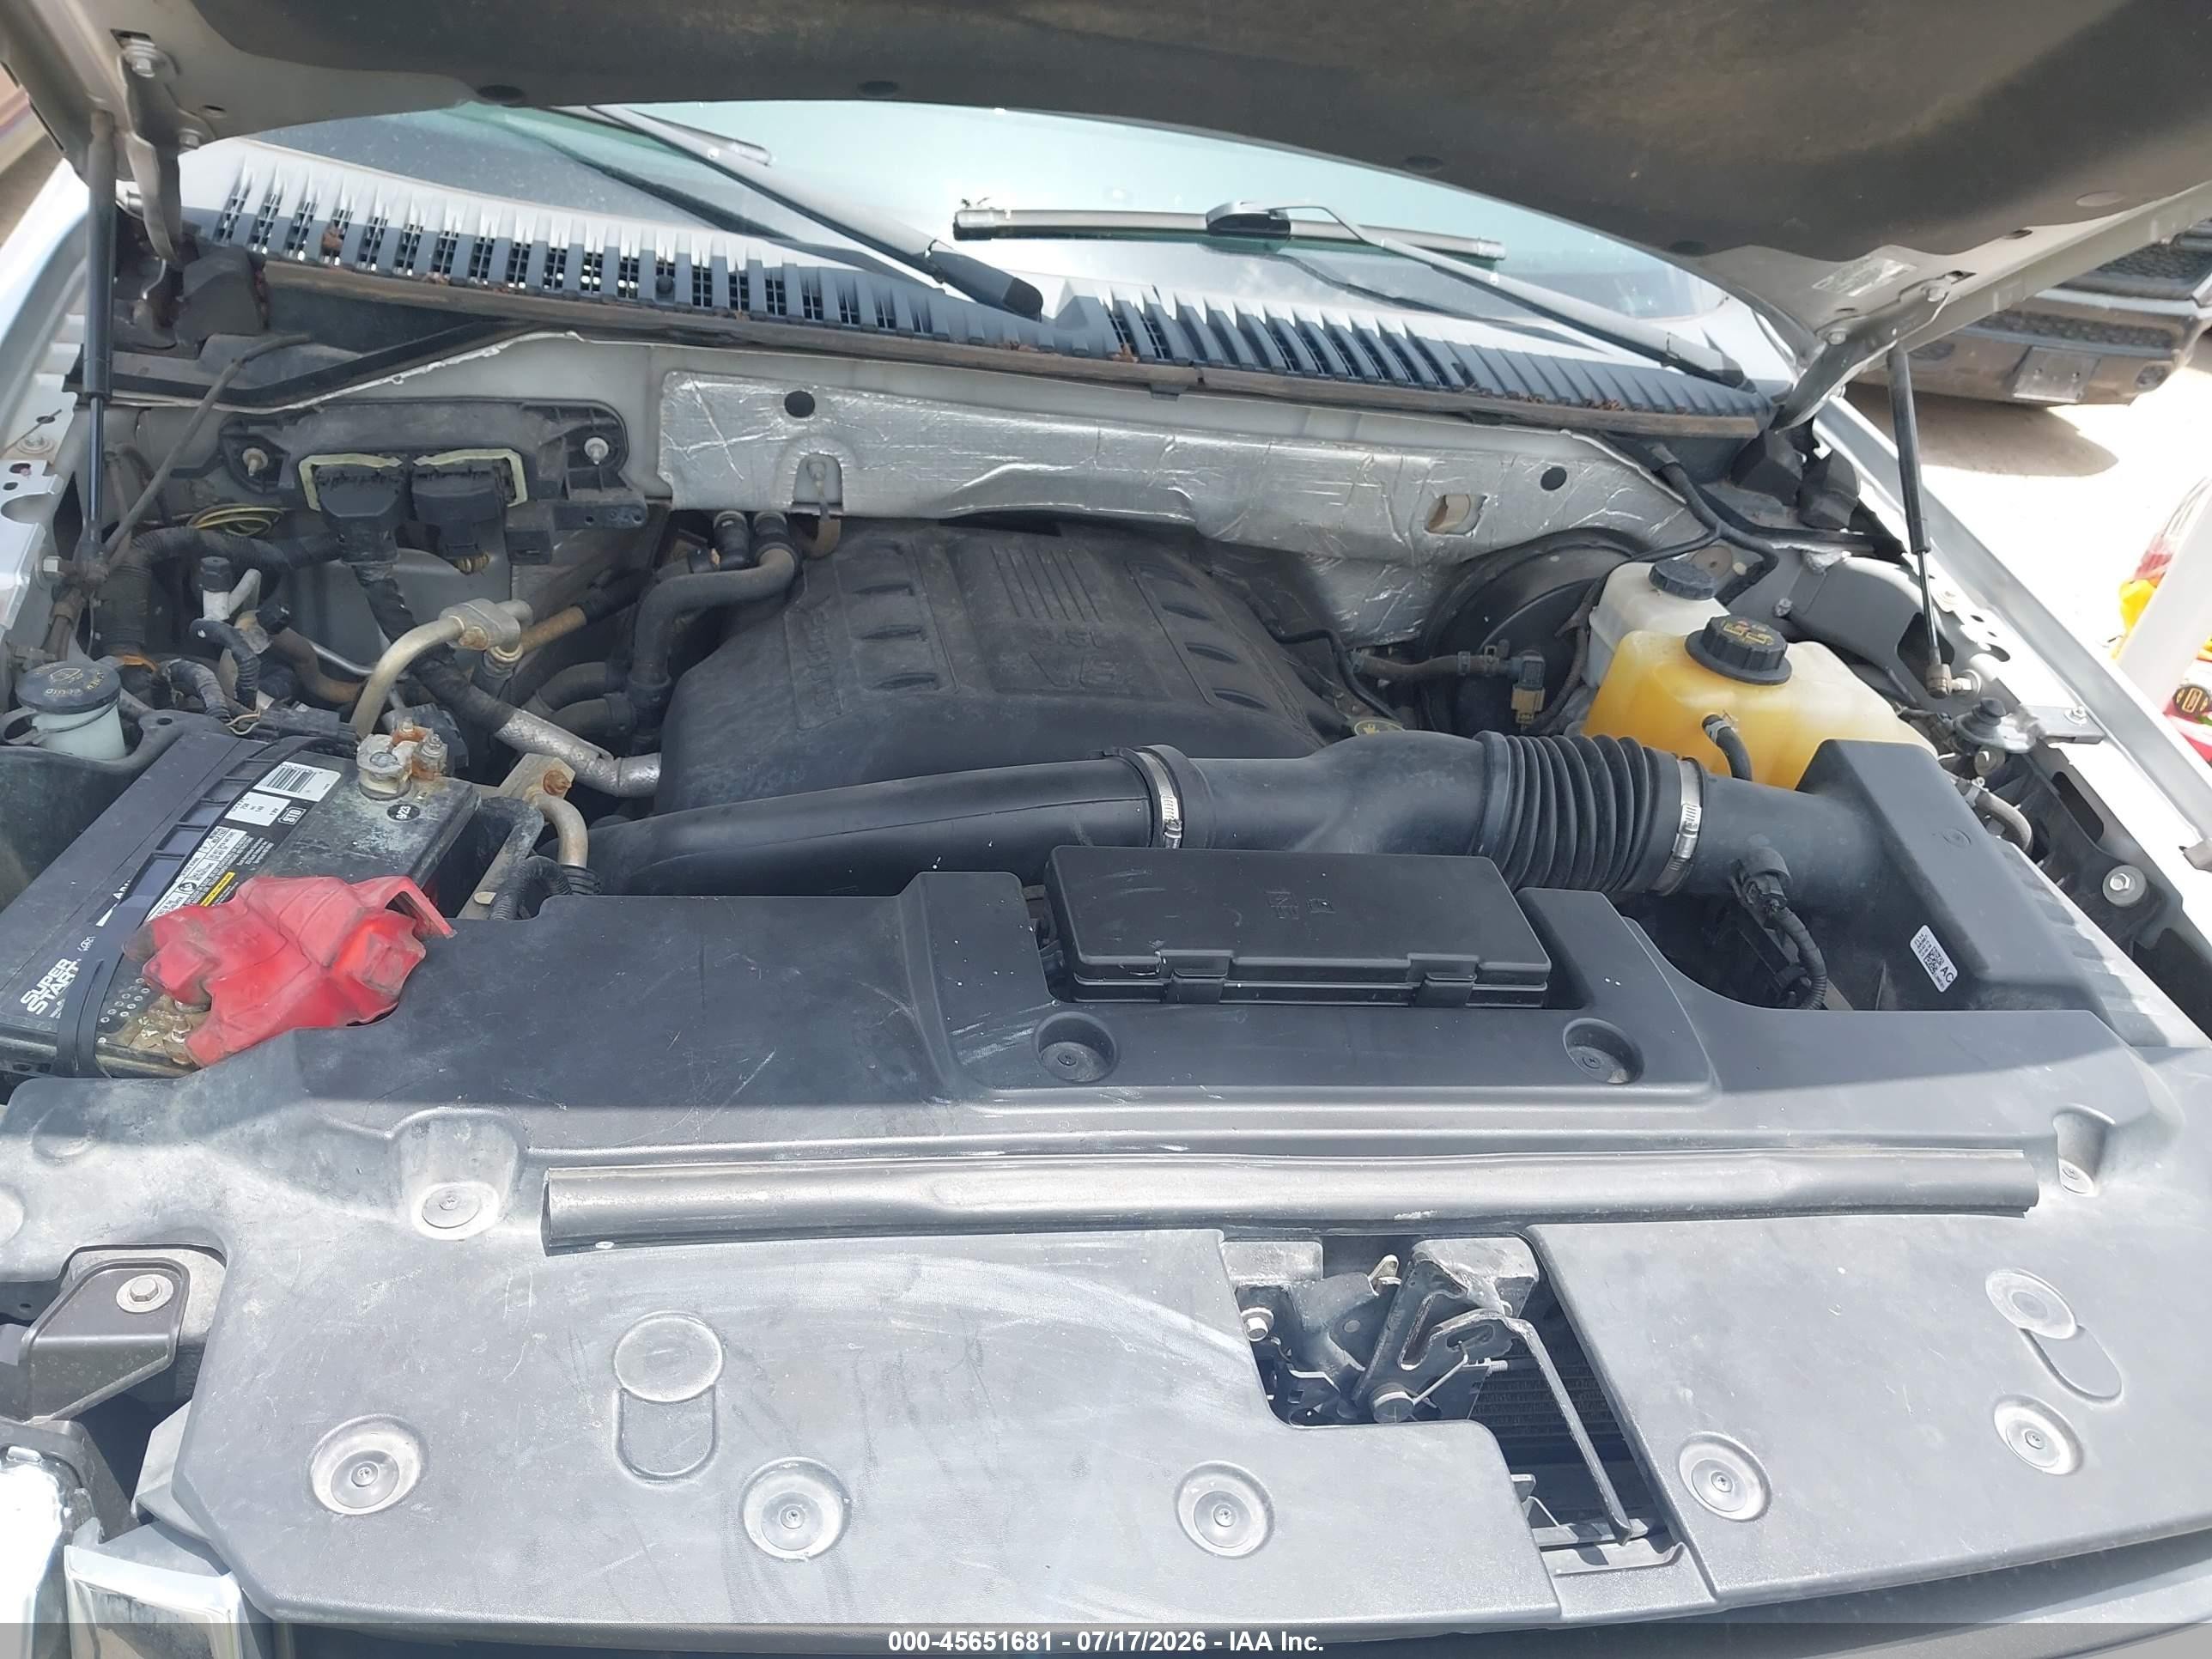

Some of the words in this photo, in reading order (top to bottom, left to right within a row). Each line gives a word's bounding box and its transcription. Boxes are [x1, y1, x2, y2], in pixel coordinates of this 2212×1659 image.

[396, 805, 411, 818] 9/23
[20, 957, 73, 1004] SUPER
[27, 960, 79, 1015] START
[1940, 966, 1954, 983] AC
